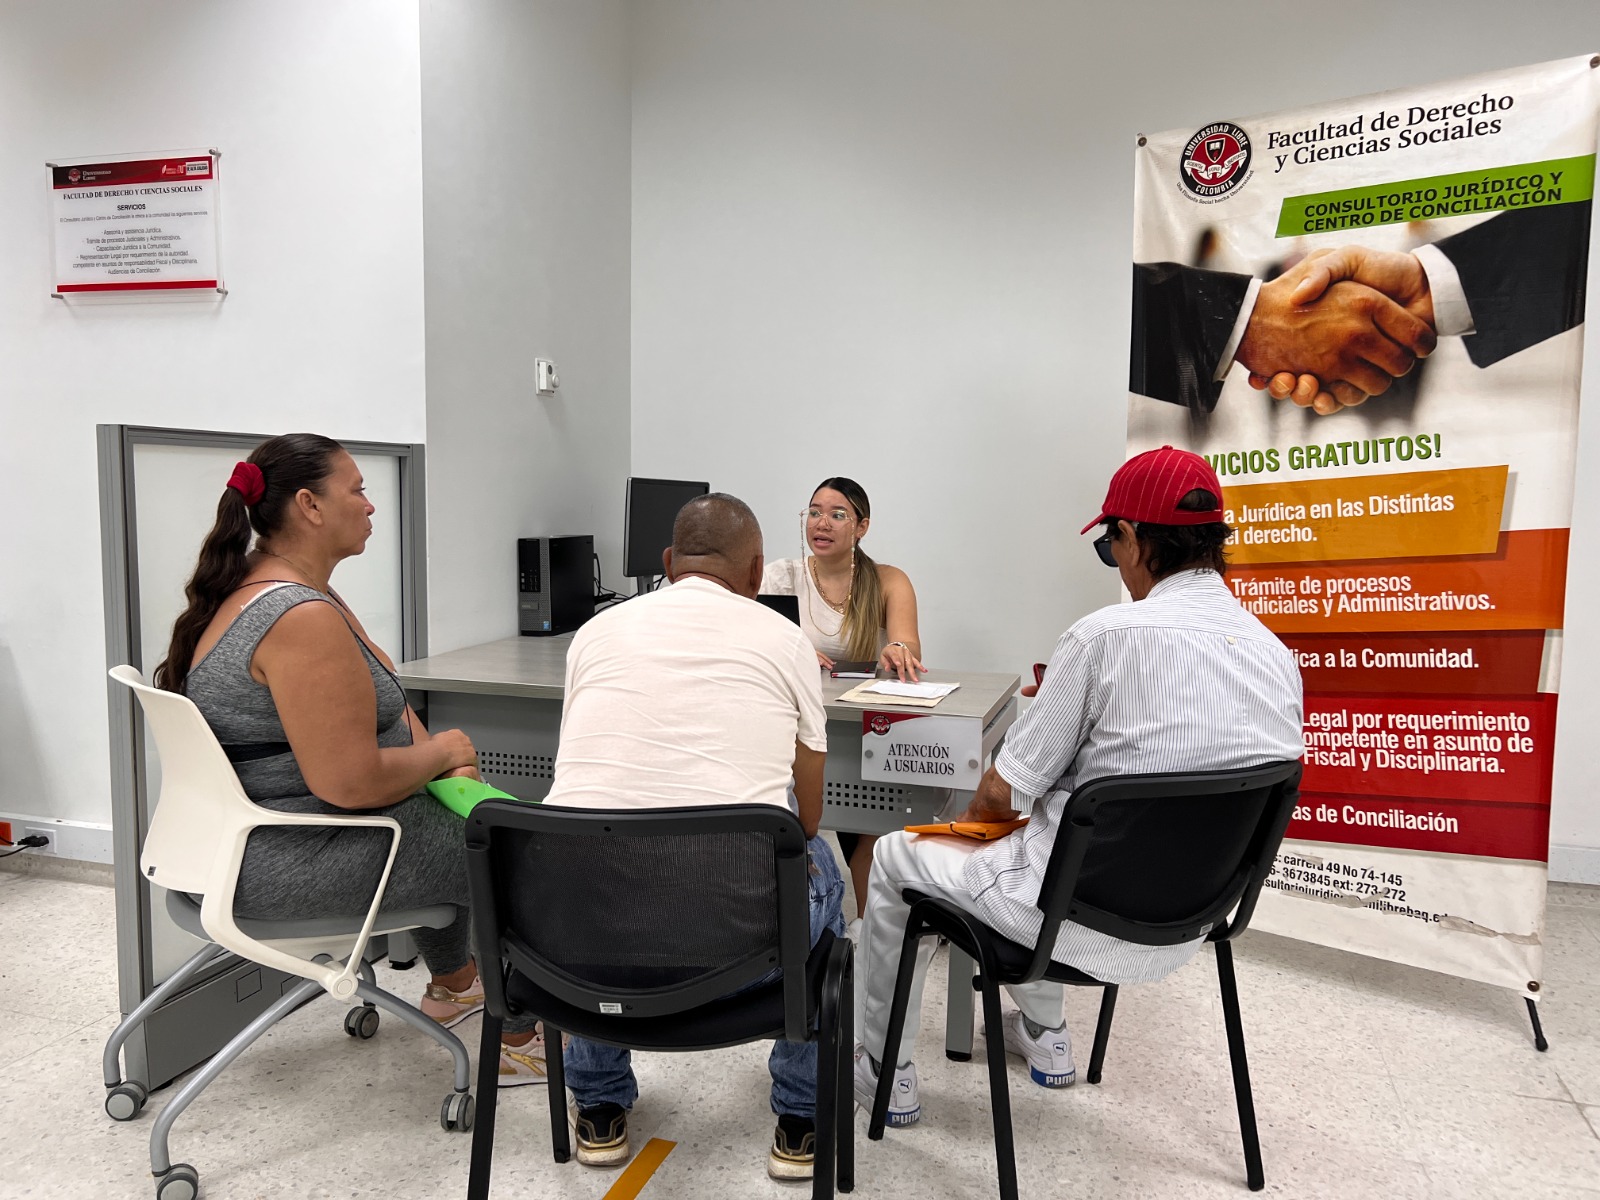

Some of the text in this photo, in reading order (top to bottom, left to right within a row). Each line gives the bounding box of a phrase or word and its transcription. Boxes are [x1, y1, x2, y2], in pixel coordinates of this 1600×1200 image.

[1267, 93, 1514, 150] Facultad de Derecho
[1184, 124, 1248, 156] UNIVERSIDAD LIBRE
[1274, 117, 1502, 173] y Ciencias Sociales
[63, 192, 94, 200] FACULTAD
[140, 187, 170, 195] CIENCIAS
[1196, 180, 1235, 195] COLOMBIA
[1230, 170, 1254, 197] Universidad
[1304, 172, 1563, 217] CONSULTORIO JURÍDICO Y
[1304, 188, 1562, 232] CENTRO DE CONCILIACIÓN
[1204, 434, 1441, 476] VICIOS GRATUITOS!
[1238, 503, 1306, 524] Jurídica
[1310, 503, 1332, 519] en
[1337, 498, 1364, 518] las
[1369, 493, 1455, 516] Distintas
[1244, 523, 1318, 545] derecho.
[1231, 576, 1412, 598] Trámite de procesos
[1323, 598, 1334, 618] y
[1337, 591, 1496, 613] Administrativos.
[1325, 653, 1336, 668] a
[1340, 650, 1357, 668] la
[1362, 648, 1479, 668] Comunidad.
[1352, 713, 1383, 733] por
[1388, 711, 1530, 734] requerimiento
[888, 743, 950, 759] ATENCIÓN
[1302, 730, 1534, 754] ompetente en asunto de
[883, 759, 955, 776] A USUARIOS
[1303, 747, 1506, 774] Fiscal y Disciplinaria.
[1316, 804, 1338, 823] de
[1342, 805, 1458, 833] Conciliación
[1282, 867, 1331, 887] 3673845
[1333, 878, 1354, 892] ext:
[1356, 882, 1406, 902] 273-272
[1326, 862, 1340, 875] 49
[1342, 864, 1358, 878] No
[1361, 868, 1403, 886] 74-145
